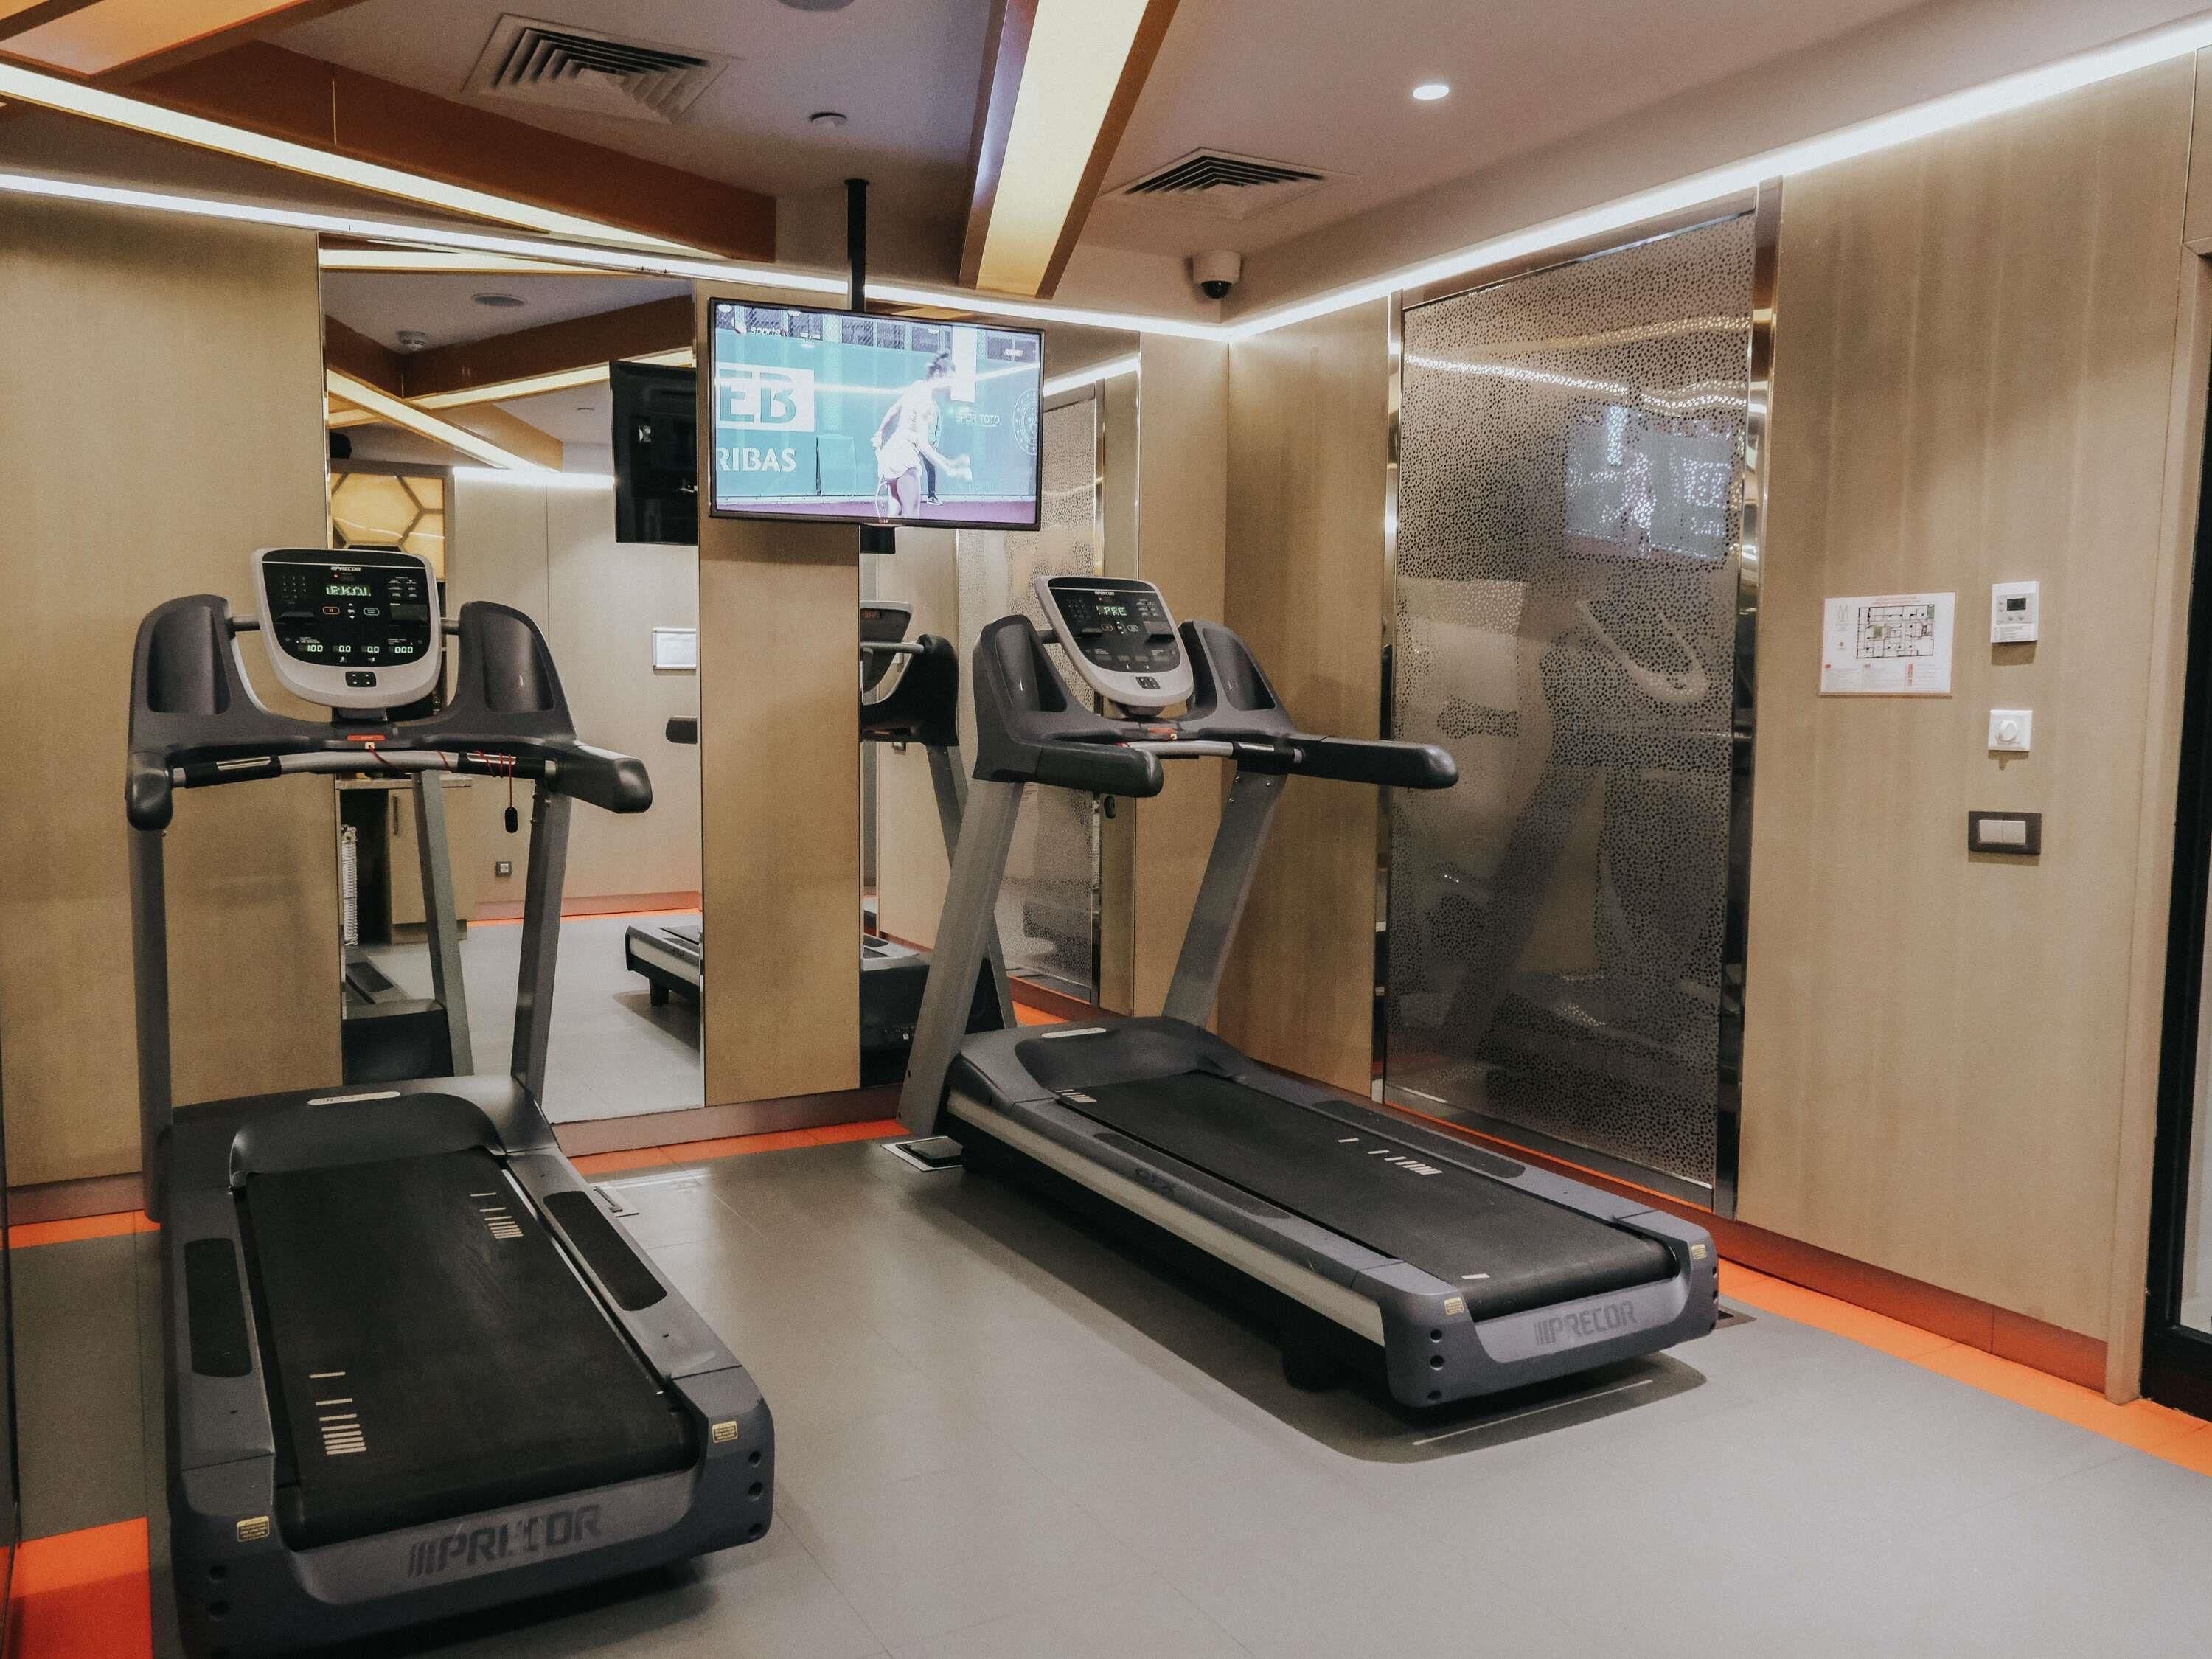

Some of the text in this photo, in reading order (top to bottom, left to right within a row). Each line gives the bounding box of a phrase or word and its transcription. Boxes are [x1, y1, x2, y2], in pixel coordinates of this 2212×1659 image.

[751, 327, 781, 336] sports
[956, 412, 1001, 425] SPOR TOTO
[716, 446, 797, 473] RIBAS
[1548, 1298, 1639, 1344] PRECOR
